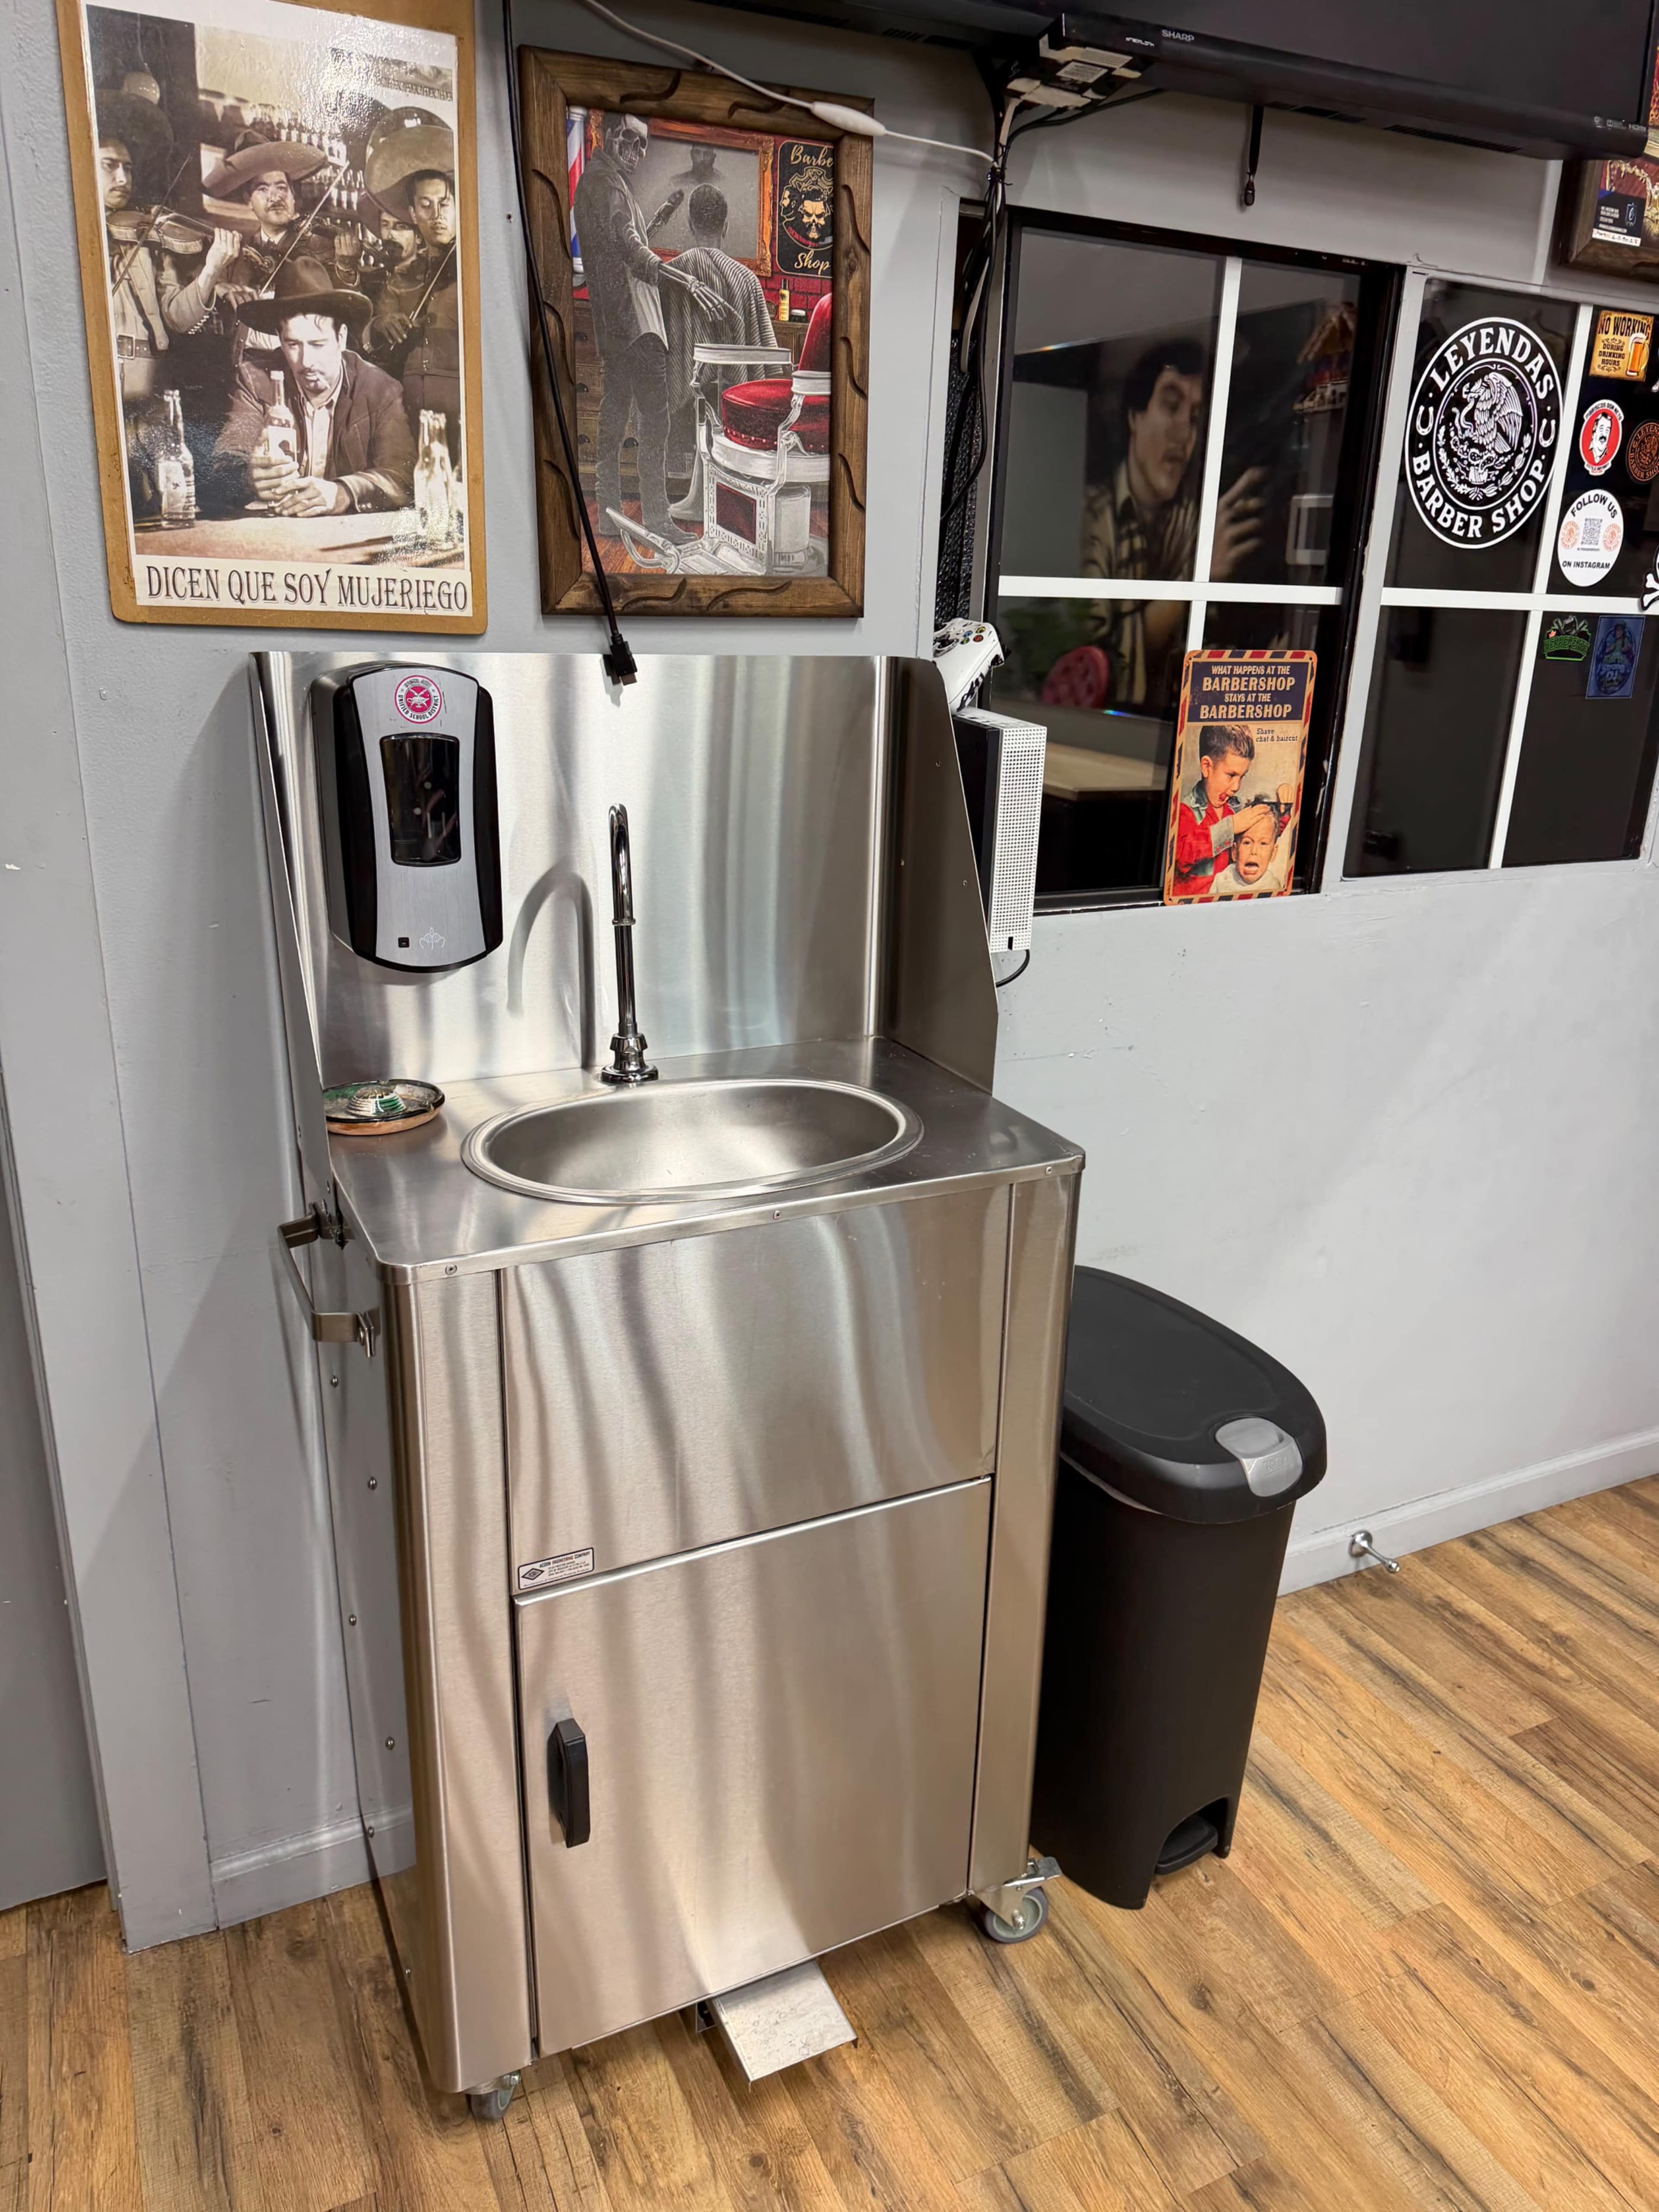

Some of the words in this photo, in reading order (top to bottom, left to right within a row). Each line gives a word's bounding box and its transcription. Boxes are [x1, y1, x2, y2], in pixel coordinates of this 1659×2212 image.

[1162, 29, 1195, 42] SHARP
[790, 145, 834, 168] Barbe
[794, 250, 831, 276] Shop
[1599, 317, 1611, 335] NO
[1613, 316, 1651, 341] WORKING
[1599, 350, 1625, 360] DRINKING
[1602, 343, 1624, 352] DURING
[1430, 327, 1554, 399] LEYENDAS
[1637, 424, 1659, 439] LEYEN
[1413, 450, 1482, 538] BARBER
[1492, 459, 1545, 534] SHOP
[1570, 493, 1608, 517] FOLLOW
[1607, 502, 1618, 519] US
[145, 565, 221, 602] DICEN
[228, 570, 276, 605] QUE
[284, 567, 332, 606] SOY
[337, 575, 468, 615] MUJERIEGO
[1211, 665, 1232, 675] WHAT
[1233, 665, 1265, 675] HAPPENS
[1266, 665, 1276, 675] AT
[1277, 665, 1290, 675] THE
[1202, 677, 1295, 691] BARBERSHOP
[398, 694, 410, 715] UNIFIED
[428, 695, 439, 716] DISTRICT
[1224, 693, 1246, 702] STAYS
[1247, 694, 1256, 702] AT
[1258, 693, 1271, 702] THE
[1199, 704, 1292, 719] BARBERSHOP
